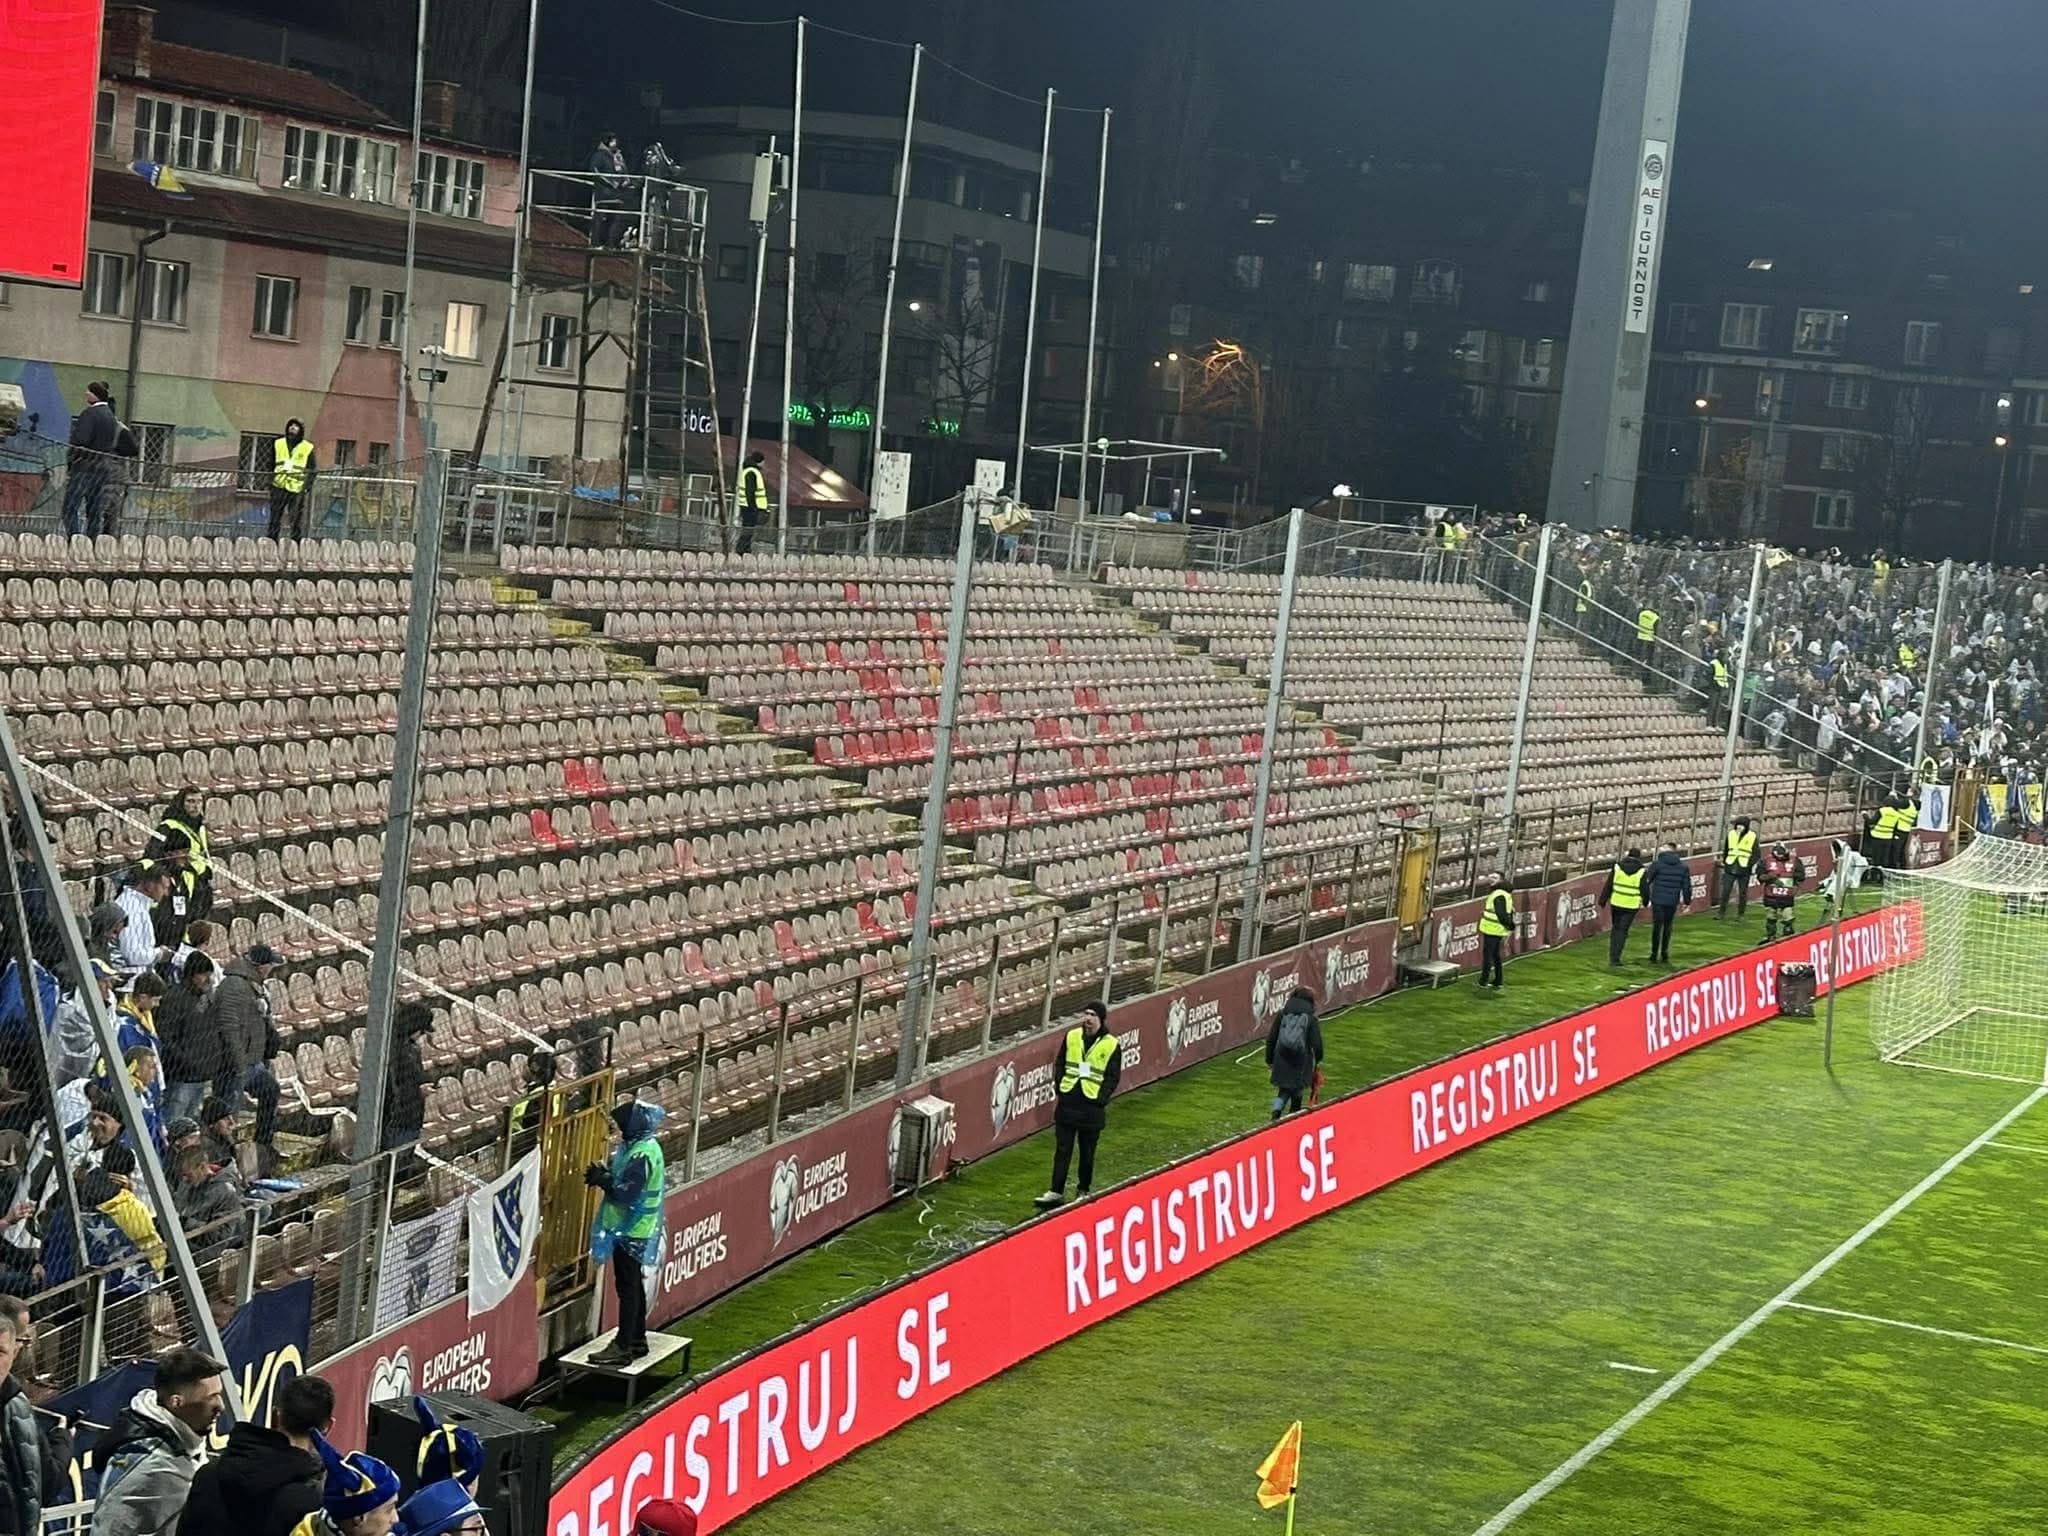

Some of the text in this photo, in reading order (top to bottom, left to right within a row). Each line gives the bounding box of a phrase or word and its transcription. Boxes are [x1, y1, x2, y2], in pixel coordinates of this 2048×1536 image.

[1633, 187, 1661, 320] AE SIGURNOST
[1893, 914, 1910, 955] SE
[1645, 959, 1776, 1054] REGISTRUJ SE
[1411, 1024, 1599, 1154] REGISTRUJ SE
[795, 1172, 849, 1223] QUALIFIERS
[803, 1151, 847, 1187] EUROPEAN
[673, 1211, 722, 1255] EUROPEAN
[1065, 1124, 1338, 1314] REGISTRUJ SE
[664, 1235, 728, 1293] QUALIFIERS
[422, 1330, 487, 1389] EUROPEAN
[896, 1291, 952, 1400] SE
